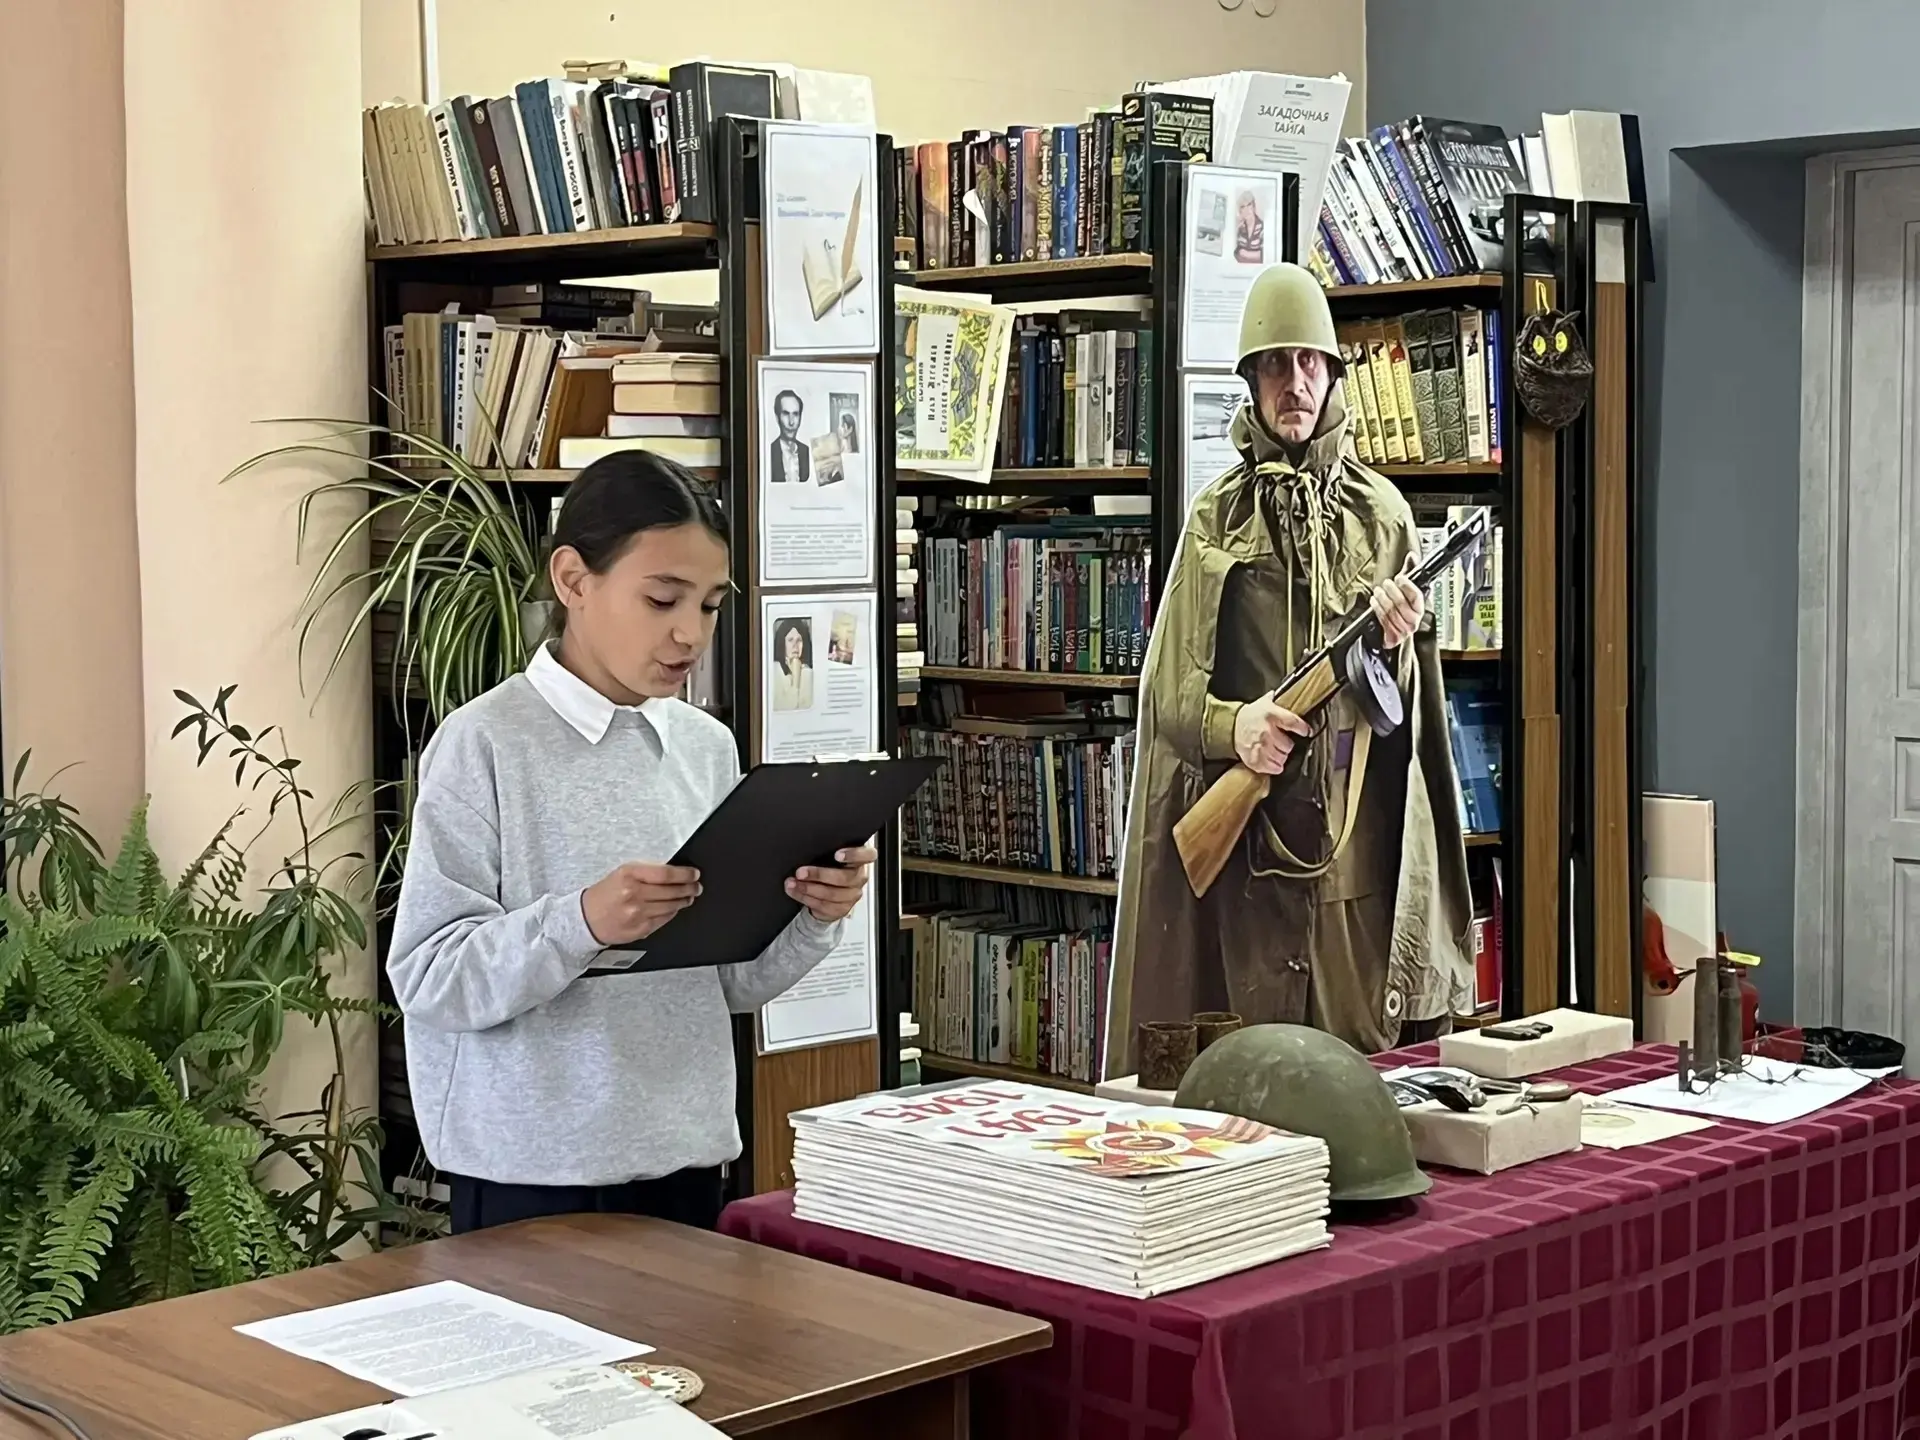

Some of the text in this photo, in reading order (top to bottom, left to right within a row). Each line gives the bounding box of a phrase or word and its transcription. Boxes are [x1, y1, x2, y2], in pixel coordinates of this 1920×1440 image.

[1257, 104, 1330, 122] ЗАГАДОЧНАЯ
[1274, 120, 1306, 135] ТАЙГА
[440, 138, 459, 188] АХМАТОВА
[566, 159, 580, 199] БРЮСОВ
[1425, 179, 1439, 205] МИРА
[861, 1089, 1027, 1124] 1945
[945, 1103, 1107, 1139] 1941
